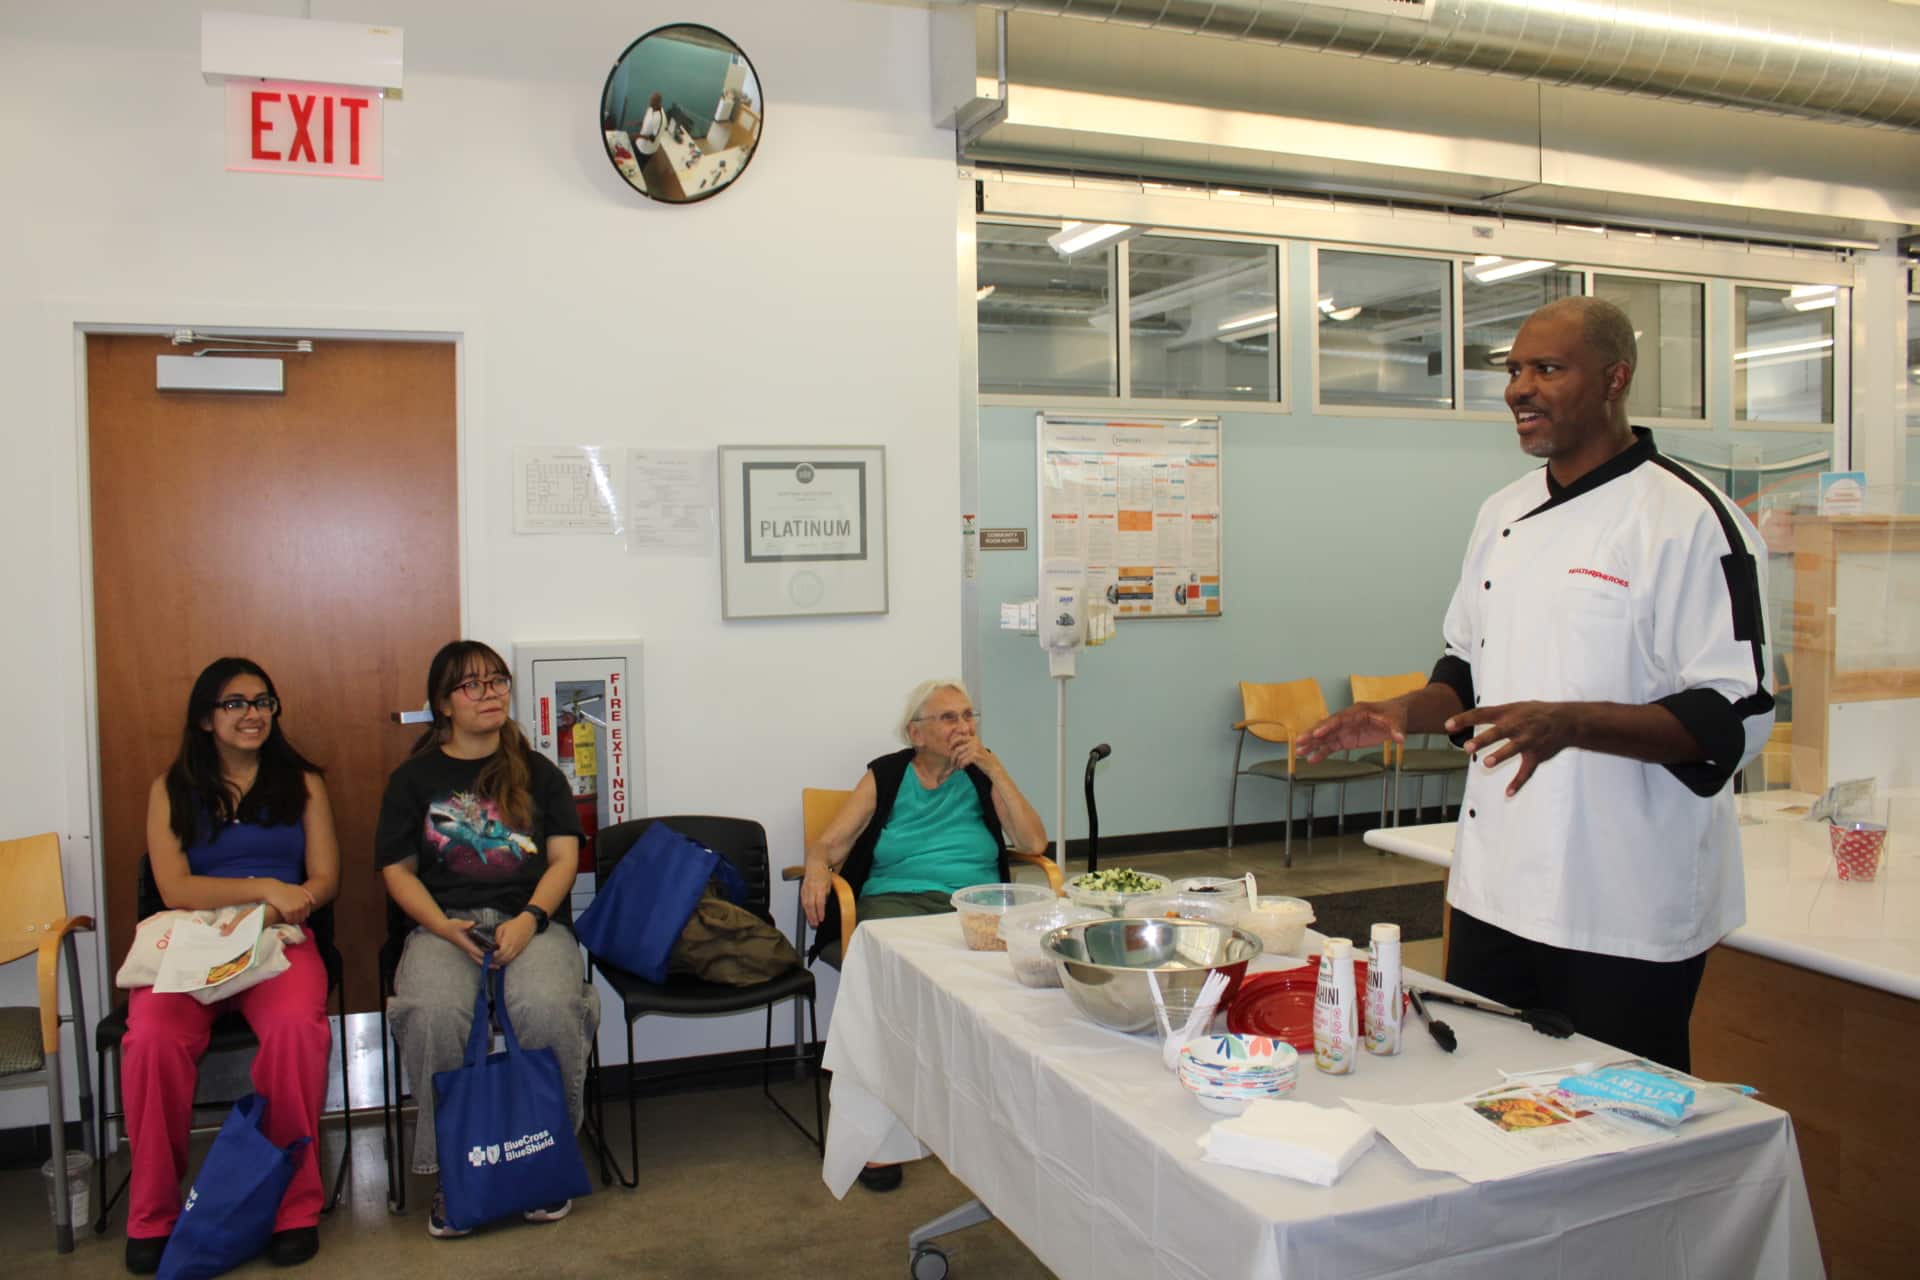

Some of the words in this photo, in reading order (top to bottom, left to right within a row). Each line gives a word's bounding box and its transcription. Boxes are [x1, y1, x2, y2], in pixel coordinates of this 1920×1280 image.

[251, 91, 369, 166] EXIT
[760, 519, 851, 538] PLATINUM
[610, 673, 622, 722] FIRE
[503, 1130, 550, 1152] BlueCross
[505, 1136, 555, 1161] BlueShield
